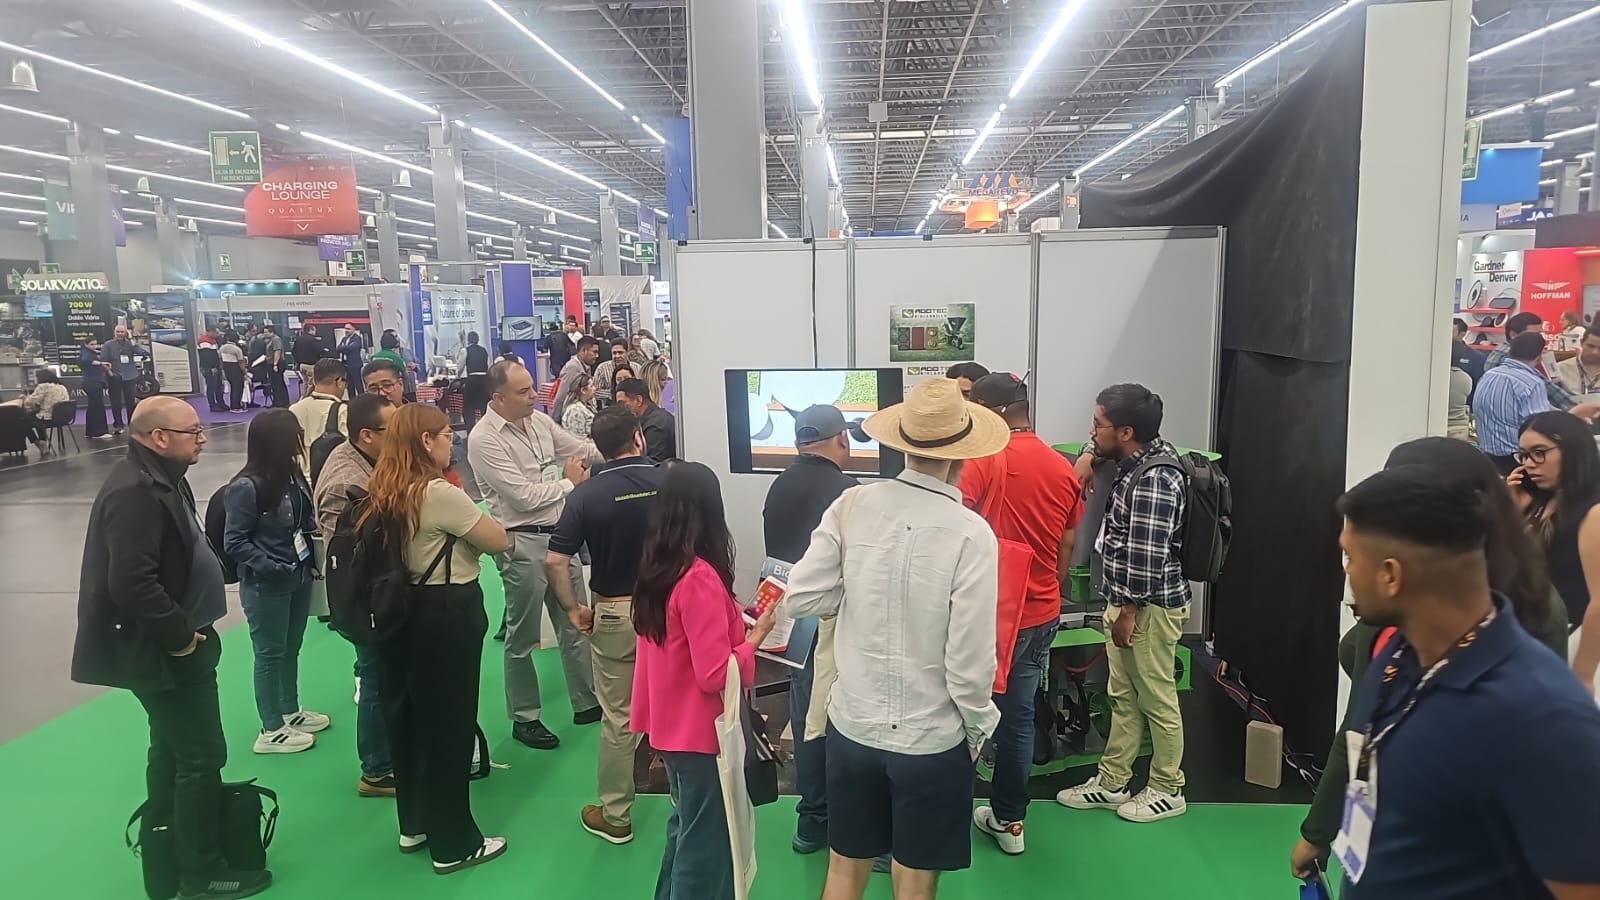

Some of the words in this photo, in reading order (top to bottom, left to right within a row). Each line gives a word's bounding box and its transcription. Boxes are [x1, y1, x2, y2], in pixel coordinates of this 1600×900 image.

[262, 180, 339, 191] CHARGING
[271, 190, 331, 201] LOUNGE
[1474, 260, 1506, 271] Gardner
[1489, 272, 1518, 283] Denver
[1530, 291, 1571, 300] HOFFMAN
